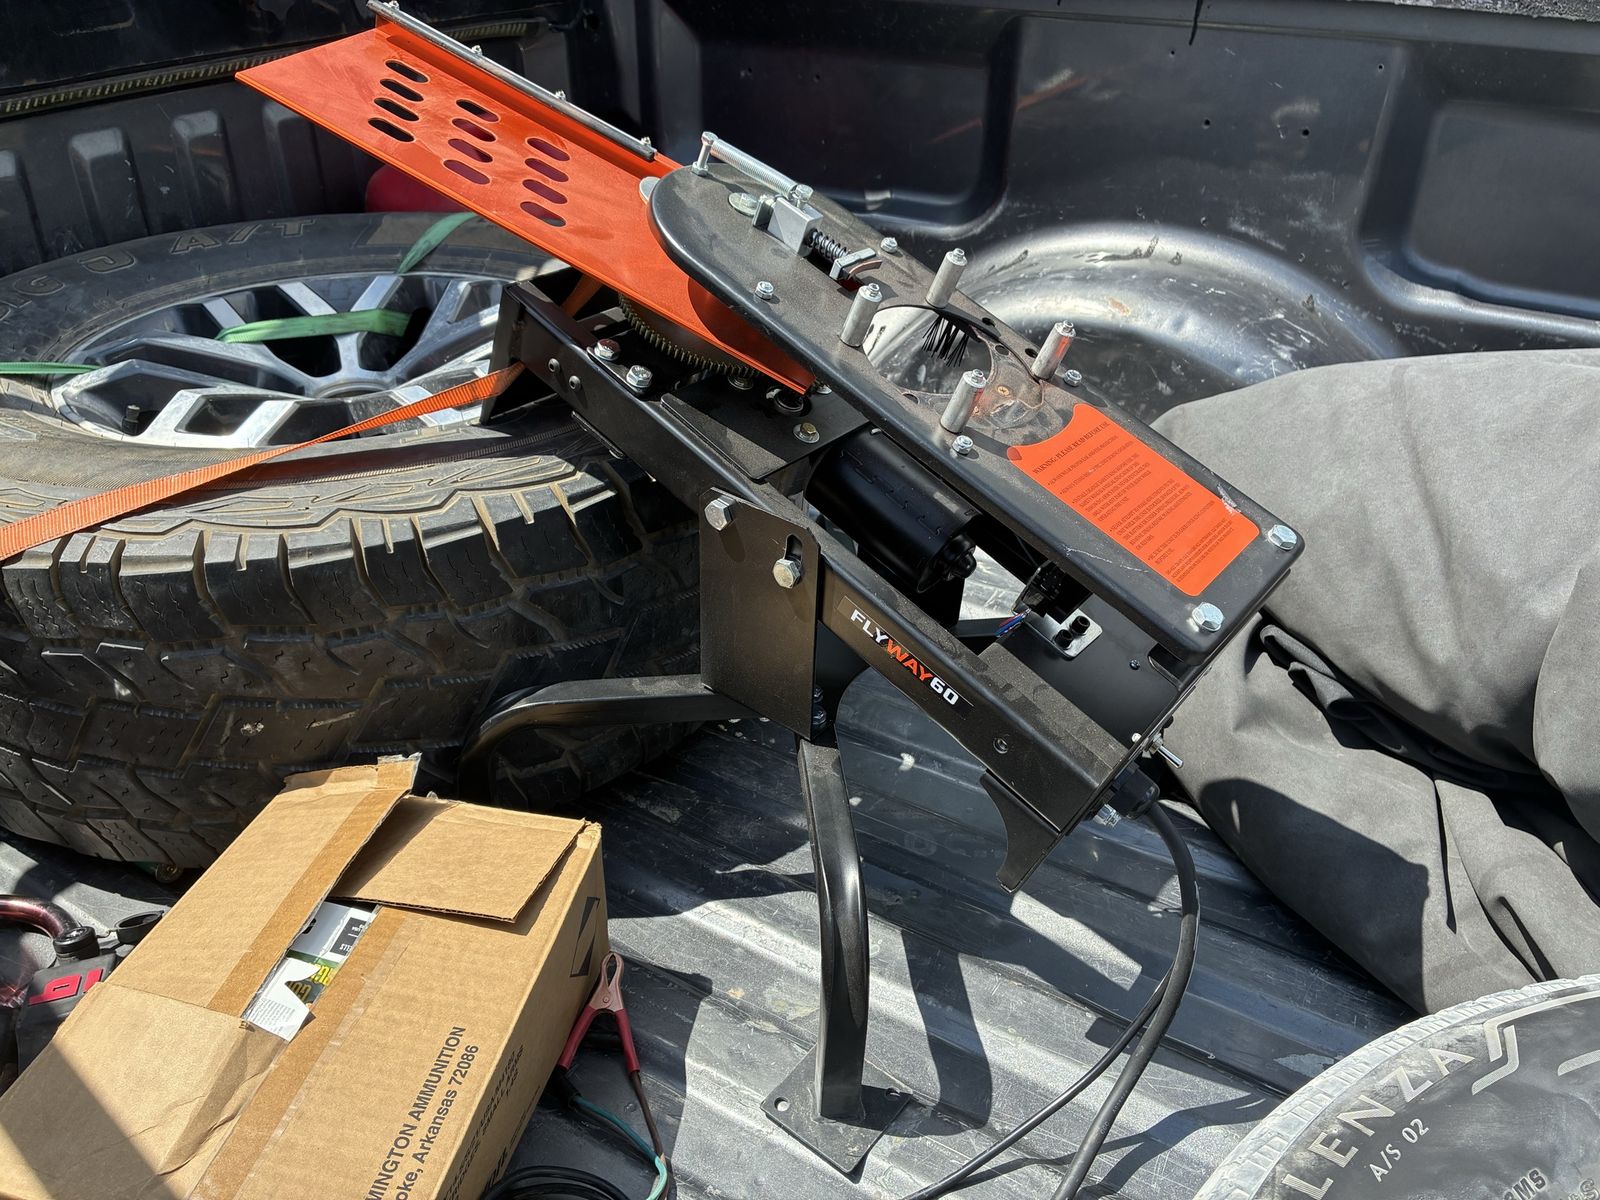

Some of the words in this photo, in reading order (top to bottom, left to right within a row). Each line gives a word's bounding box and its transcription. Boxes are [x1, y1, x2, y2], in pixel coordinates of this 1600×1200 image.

[170, 218, 316, 255] A/T
[850, 609, 959, 706] FLYWAY60
[407, 1026, 467, 1121] AMMUNITION
[411, 1088, 458, 1164] Arkansas
[448, 1044, 480, 1086] 72086
[1281, 1046, 1475, 1200] LENZA
[1368, 1143, 1402, 1183] A/S
[1401, 1117, 1430, 1144] 02
